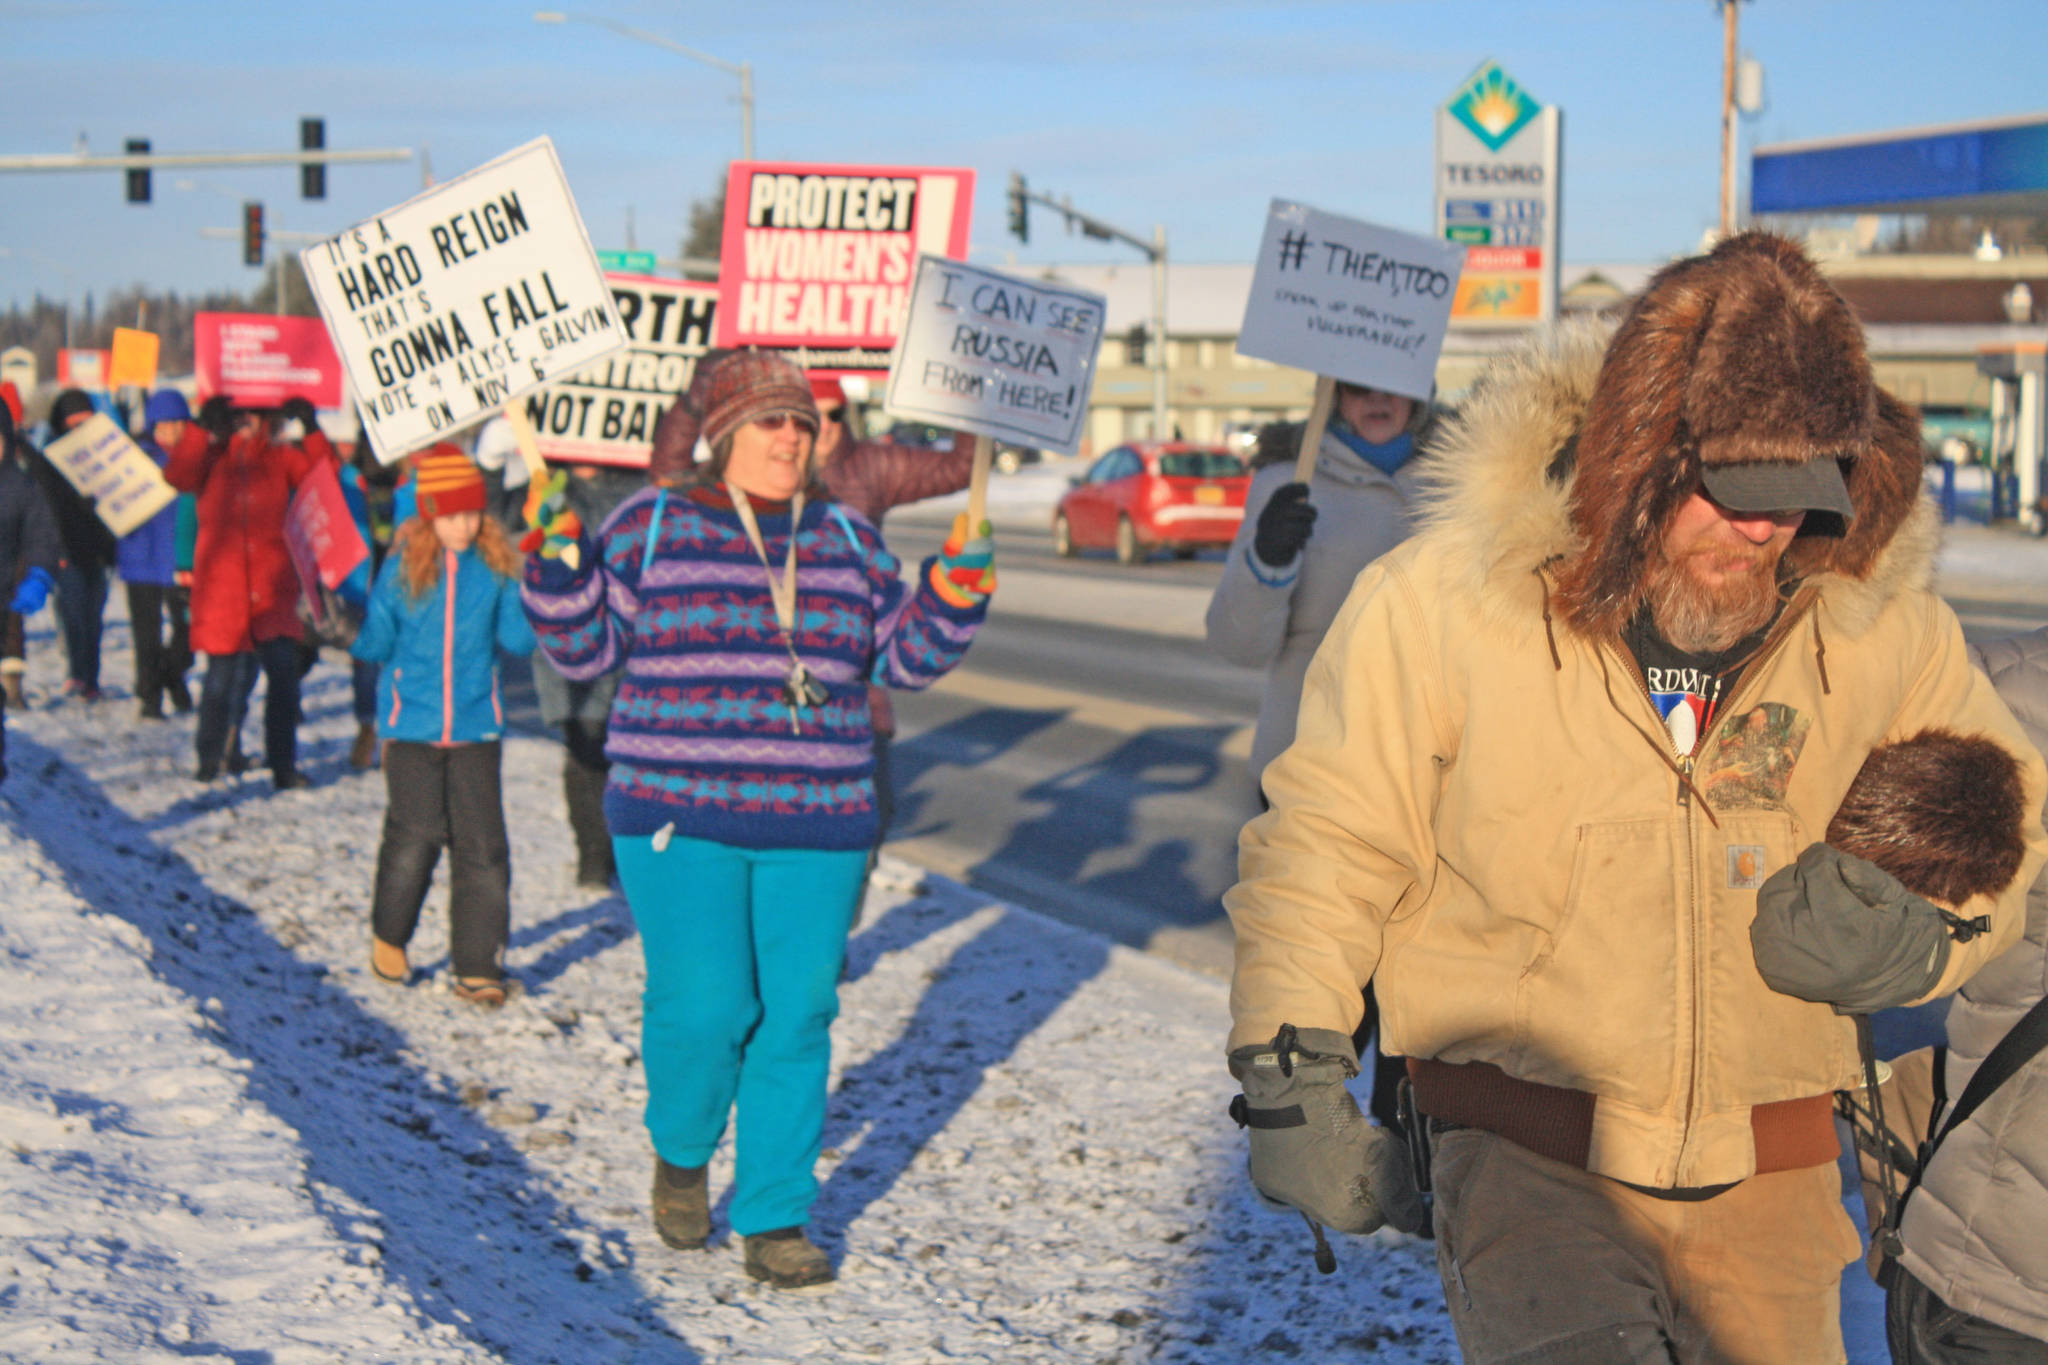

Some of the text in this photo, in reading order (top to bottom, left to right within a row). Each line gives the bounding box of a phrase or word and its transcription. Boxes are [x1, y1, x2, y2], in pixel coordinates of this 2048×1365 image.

[748, 173, 916, 231] PROTECT
[1446, 165, 1543, 184] TESORO
[326, 218, 392, 266] IT'S A
[337, 190, 529, 311] HARD REIGN
[743, 229, 911, 284] WOMEN'S
[359, 290, 431, 338] THAT'S
[370, 310, 474, 388] GONNA
[482, 271, 569, 338] FALL
[737, 280, 906, 337] HEALTH
[935, 271, 1094, 334] I CAN SEE
[367, 305, 611, 422] VOTE 4 ALYSE GALVIN
[952, 324, 1060, 376] RUSSIA
[427, 402, 455, 430] ON
[474, 374, 509, 409] NOV
[527, 391, 595, 438] NOT
[922, 360, 1075, 419] FROM HERE!
